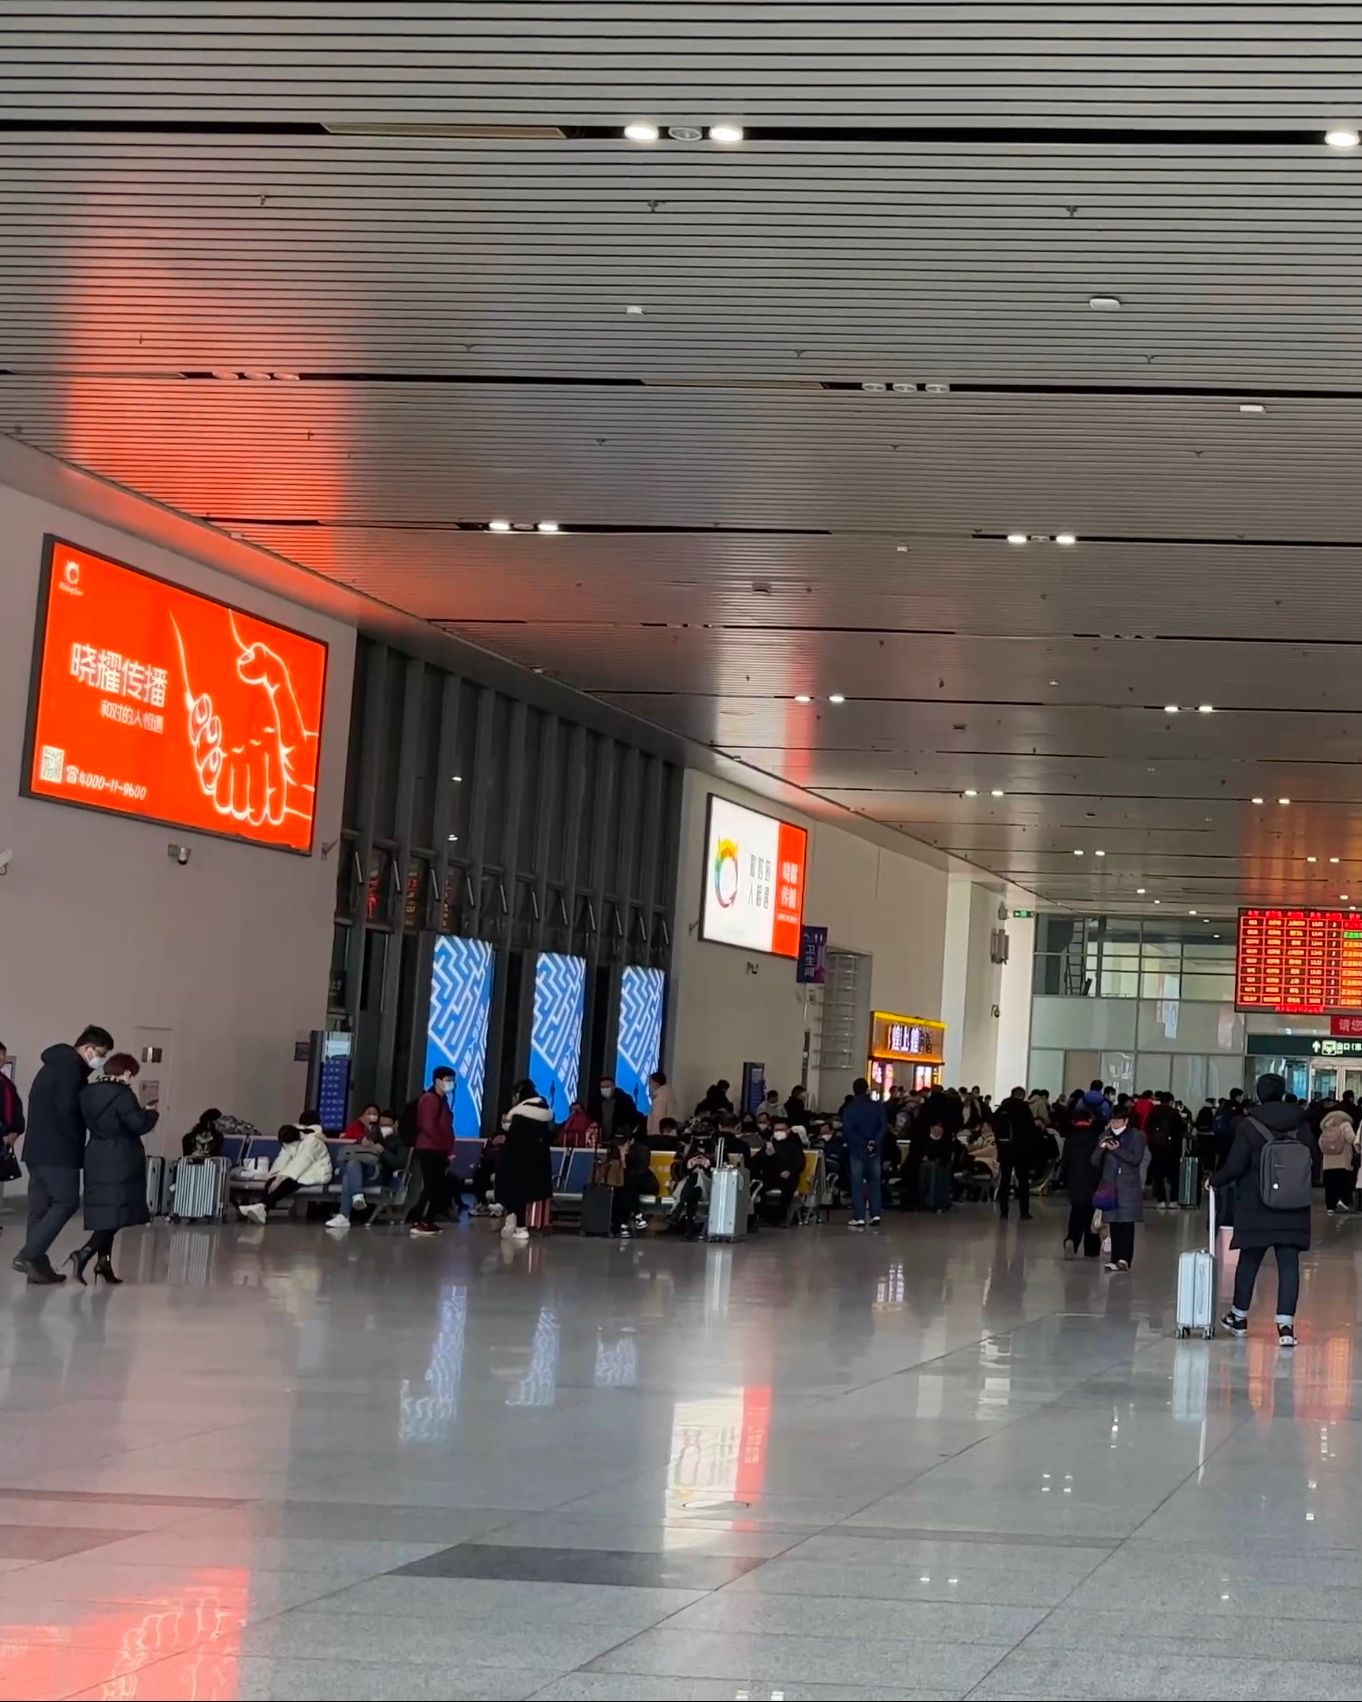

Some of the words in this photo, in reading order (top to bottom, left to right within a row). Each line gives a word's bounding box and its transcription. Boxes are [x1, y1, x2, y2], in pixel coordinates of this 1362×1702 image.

[70, 642, 168, 708] 晓耀传播
[79, 770, 148, 801] 4000-11-9600
[804, 944, 816, 978] 卫生间
